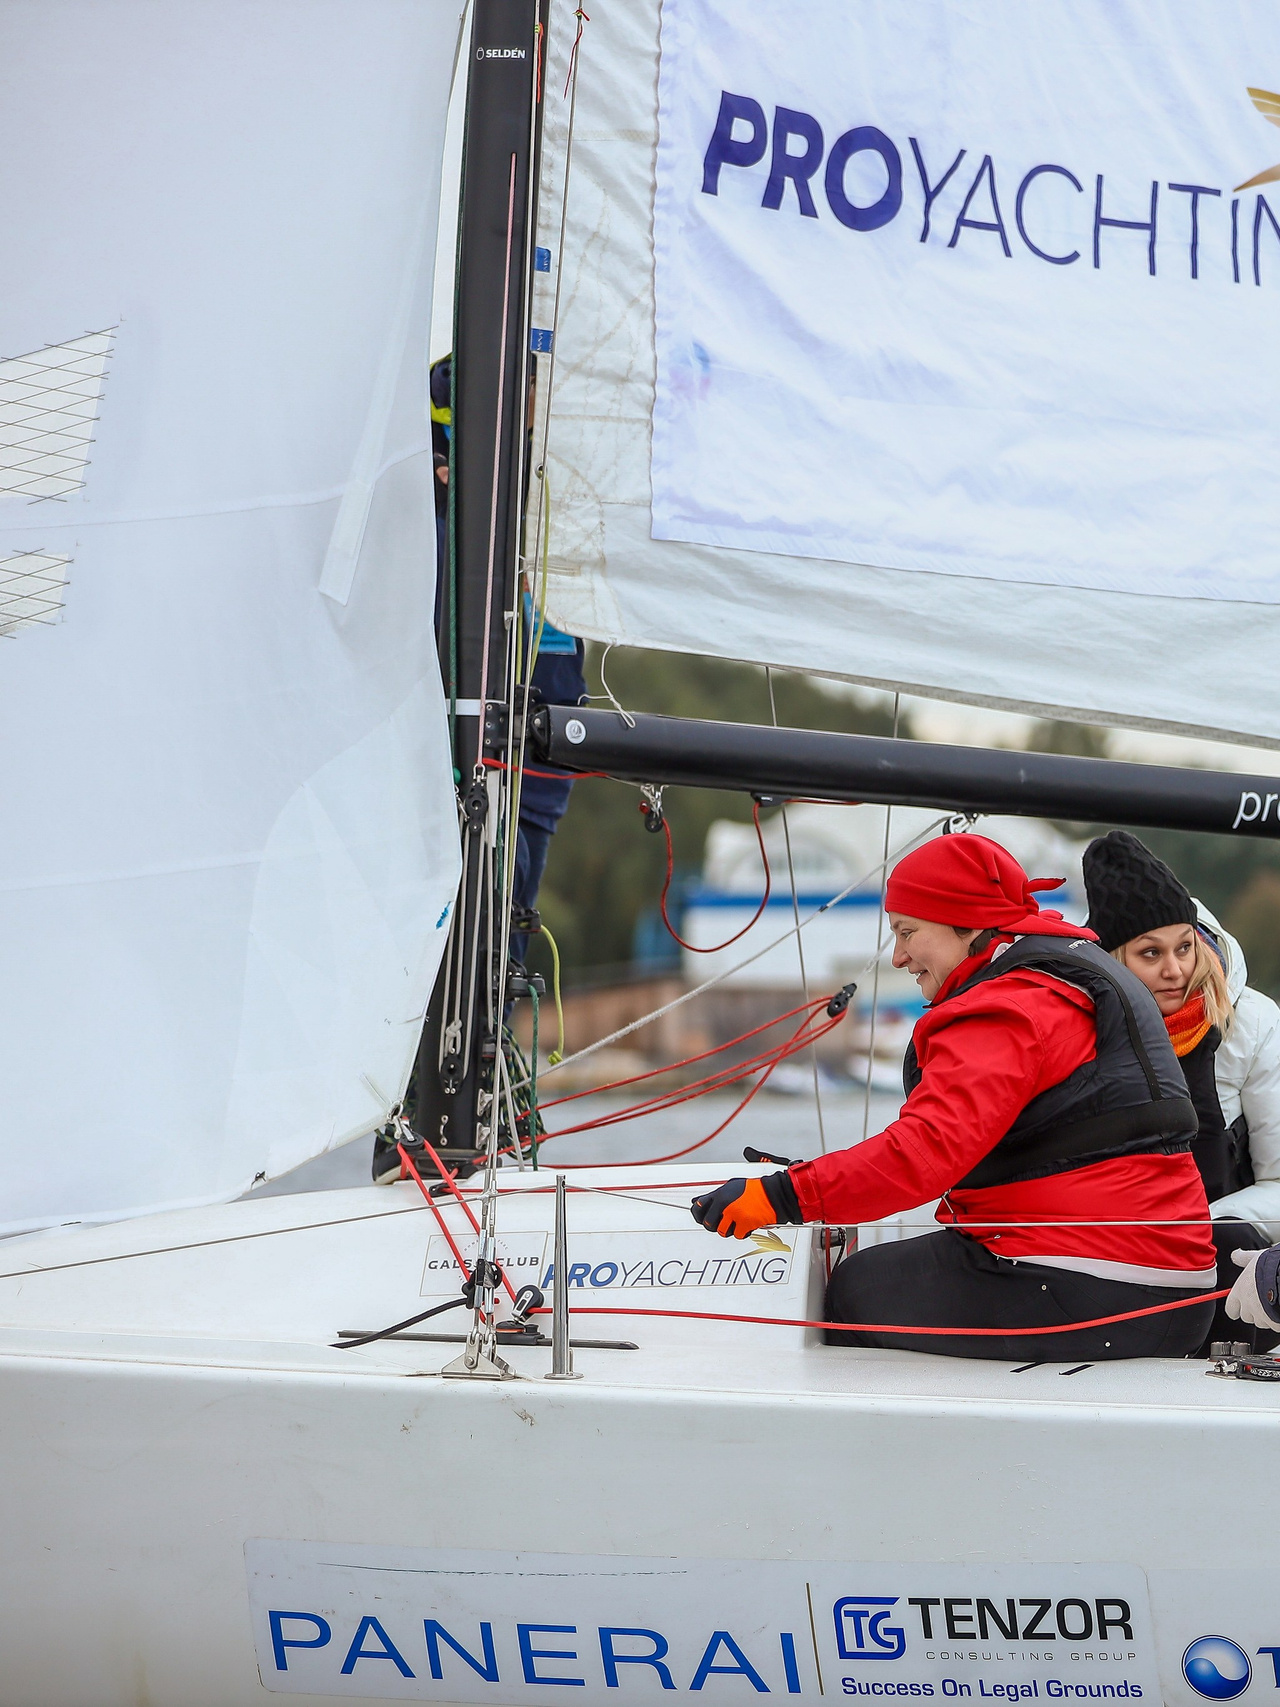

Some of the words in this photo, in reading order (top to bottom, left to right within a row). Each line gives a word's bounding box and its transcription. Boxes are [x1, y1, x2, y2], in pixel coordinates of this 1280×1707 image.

[485, 47, 526, 59] SELDÉN
[907, 1597, 1134, 1641] TENZOR
[268, 1610, 801, 1694] PANERAI
[925, 1651, 1055, 1661] CONSULTING
[1070, 1651, 1137, 1661] GROUP
[841, 1677, 935, 1697] Success
[941, 1679, 972, 1697] On
[979, 1679, 1040, 1702] Legal
[1045, 1679, 1143, 1698] Grounds
